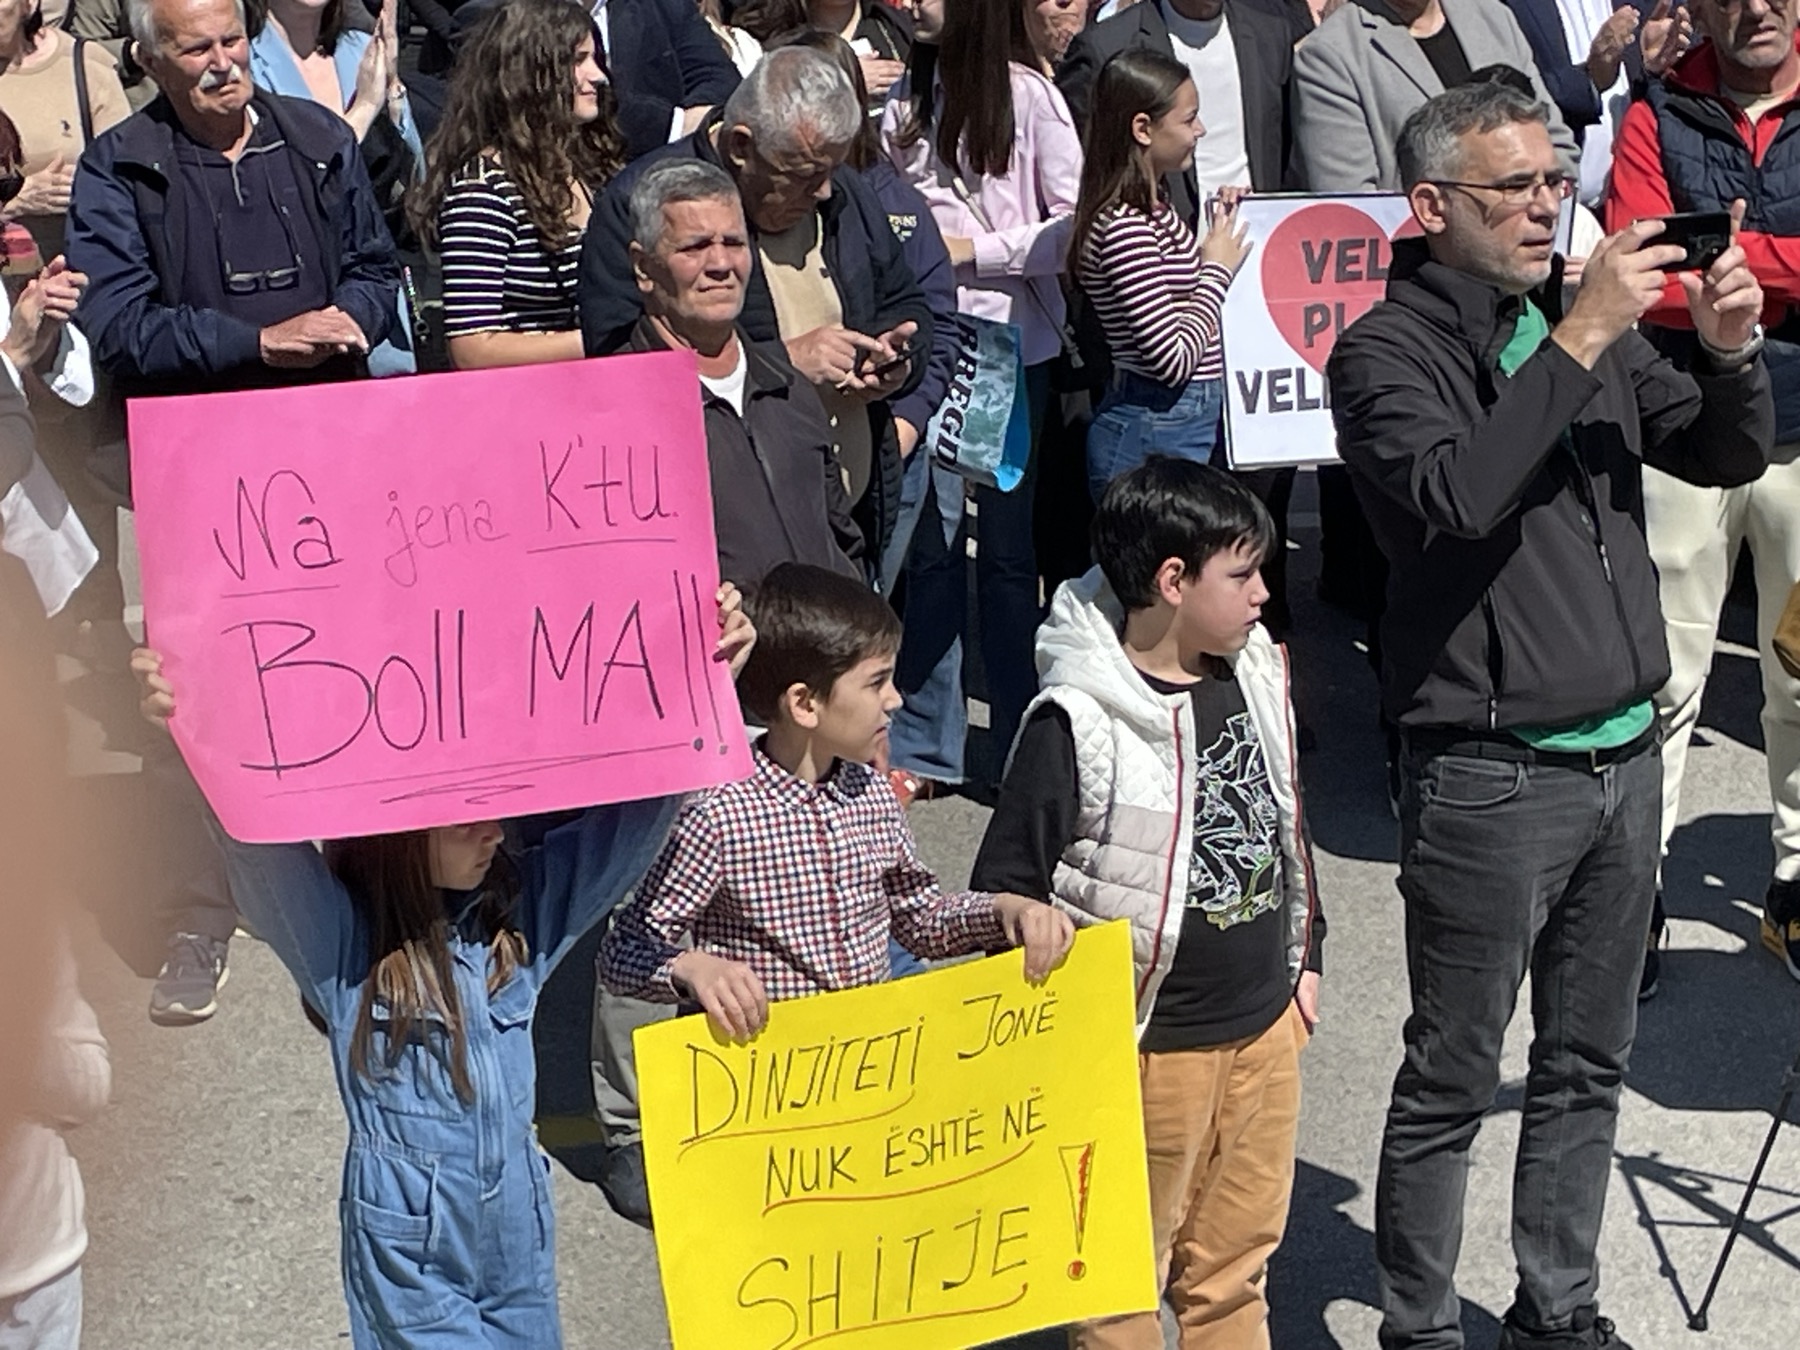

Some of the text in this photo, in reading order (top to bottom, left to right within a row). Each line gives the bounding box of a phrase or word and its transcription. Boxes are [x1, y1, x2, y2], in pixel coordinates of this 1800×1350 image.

[214, 470, 344, 580] Na
[384, 491, 510, 588] jena
[222, 609, 466, 779] Boll
[766, 1086, 1047, 1206] NUK ËSHTË NË
